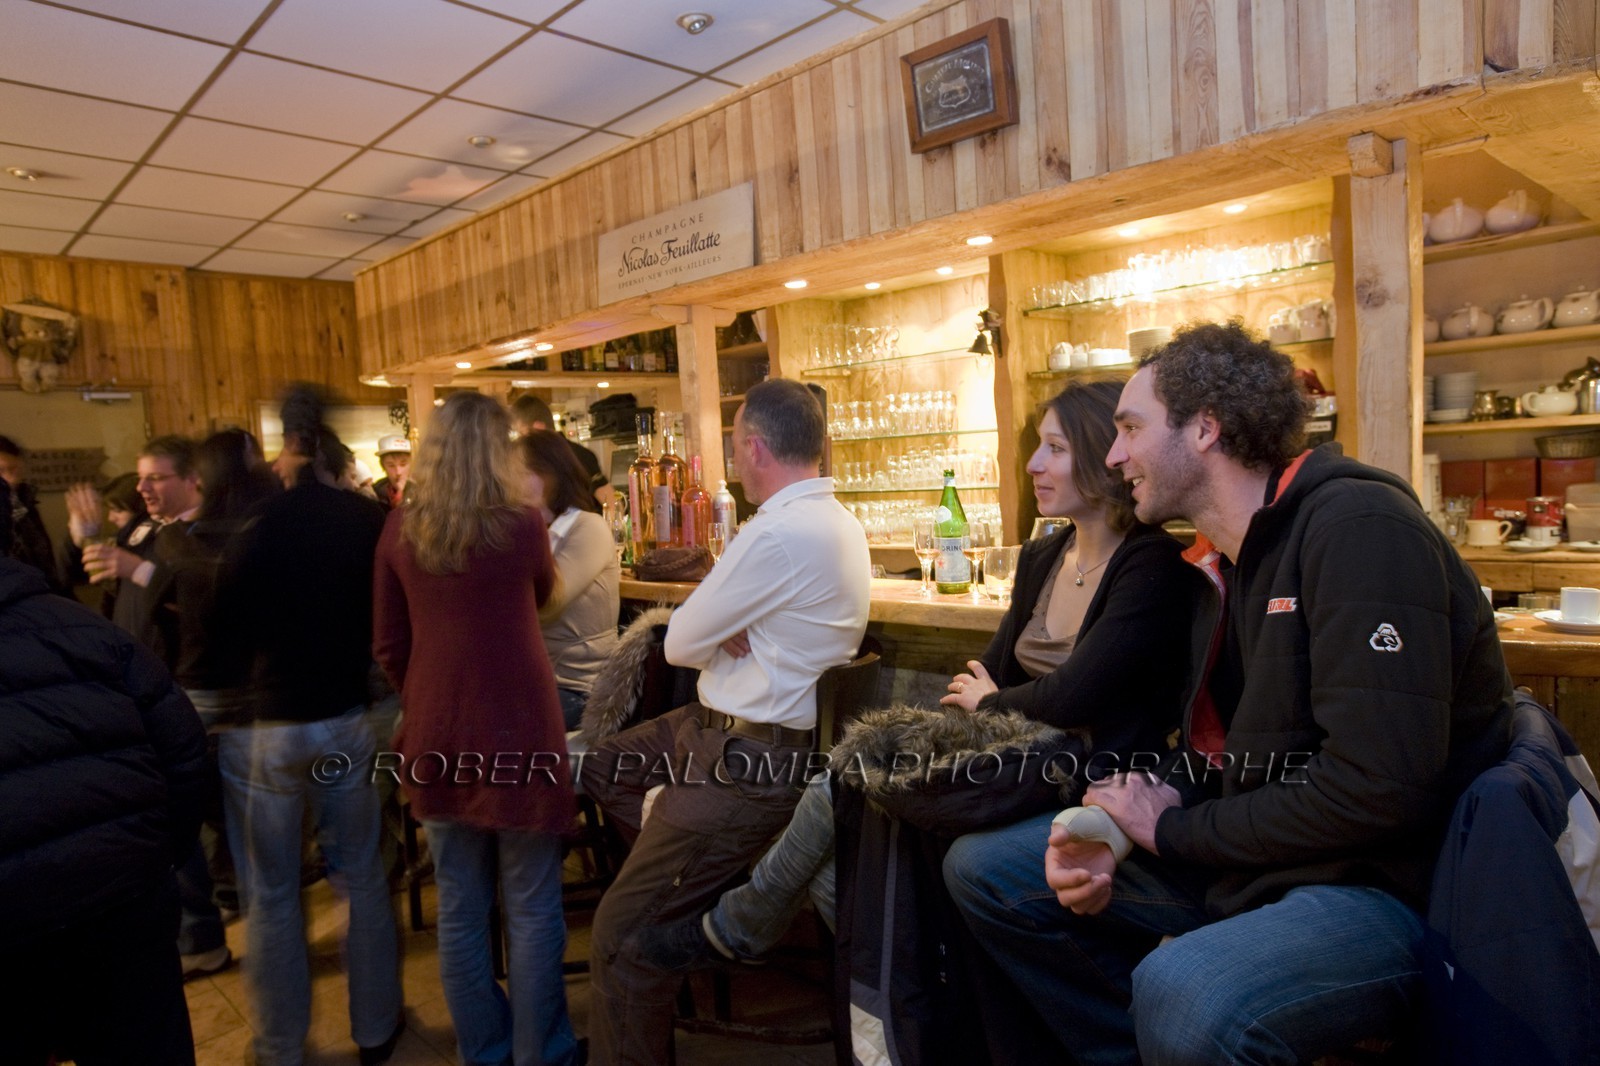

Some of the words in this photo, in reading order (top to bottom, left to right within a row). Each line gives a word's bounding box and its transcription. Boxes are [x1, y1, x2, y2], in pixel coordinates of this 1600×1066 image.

[632, 212, 704, 244] CHAMPAGNE
[618, 246, 660, 277] Nicolas
[659, 231, 721, 266] Feuillatte
